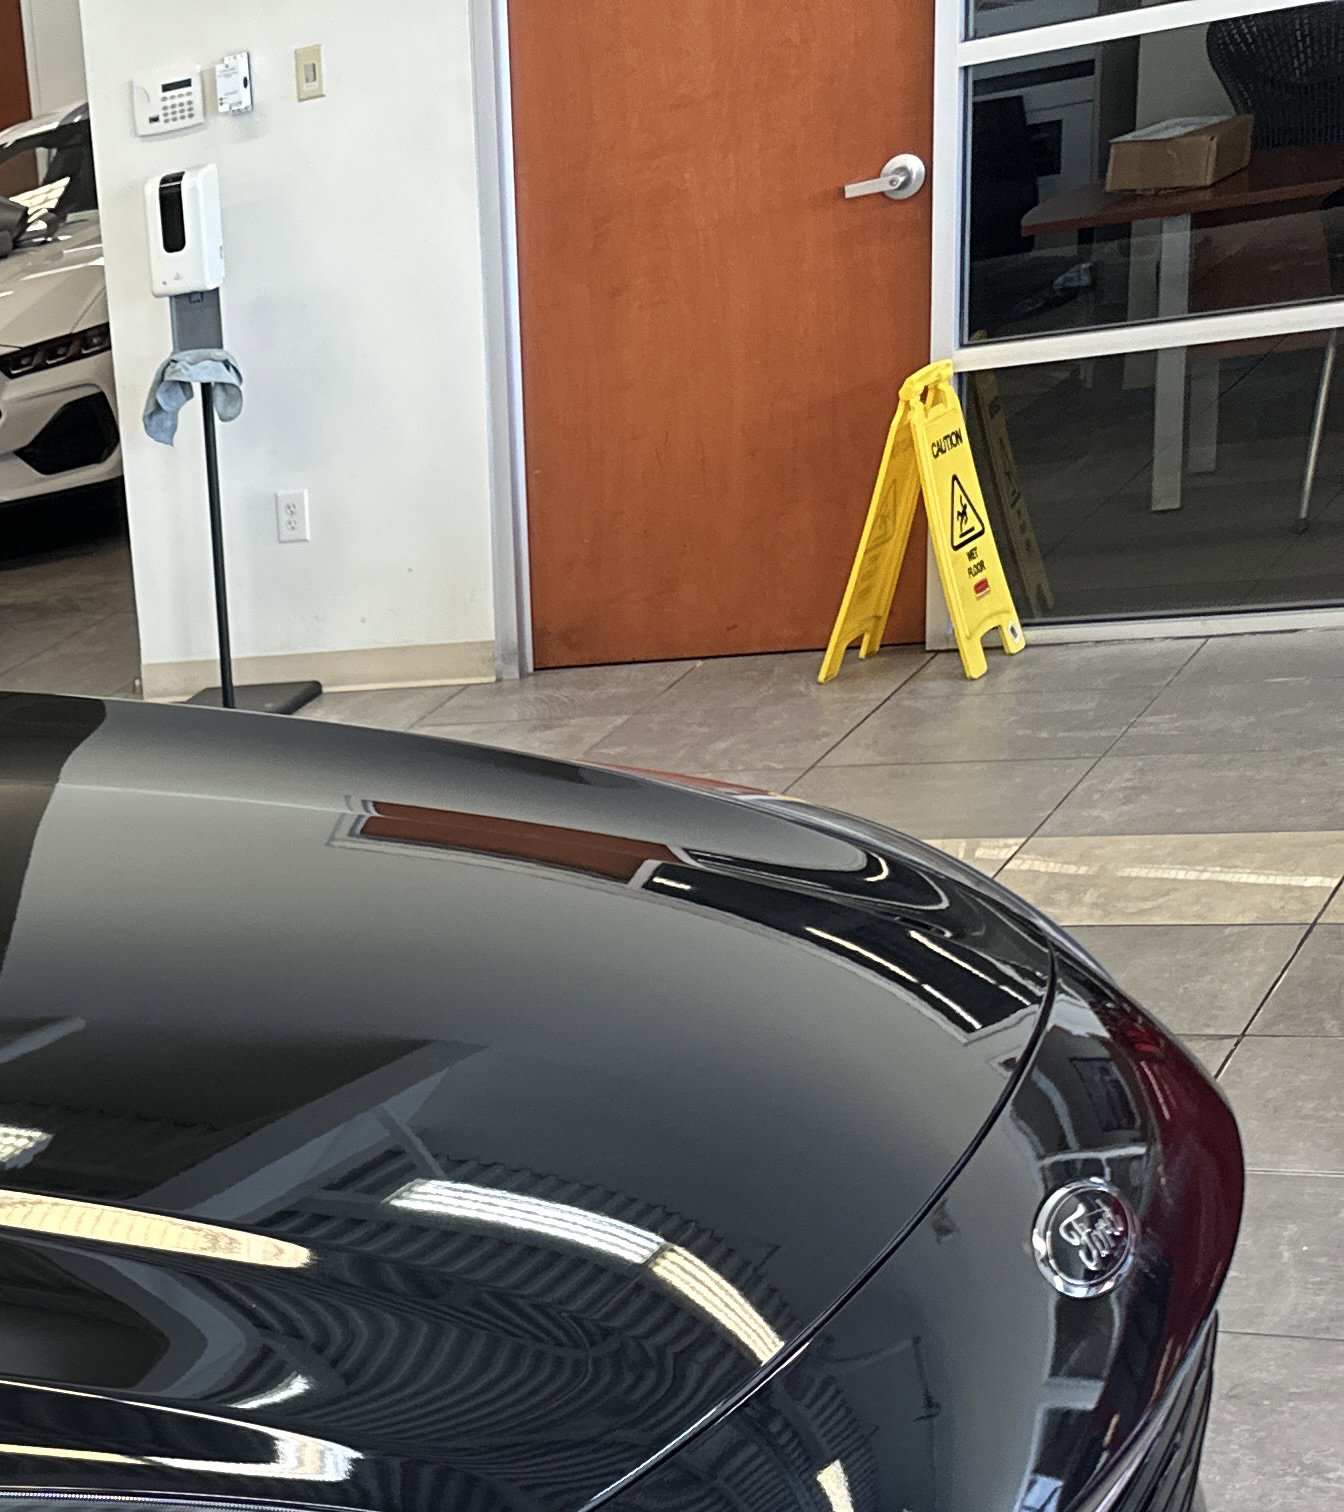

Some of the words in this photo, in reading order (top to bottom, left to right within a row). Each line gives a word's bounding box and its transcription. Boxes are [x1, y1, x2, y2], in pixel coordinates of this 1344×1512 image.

[931, 428, 963, 459] CAUTION
[966, 546, 978, 562] WET
[968, 560, 986, 578] FLOOR
